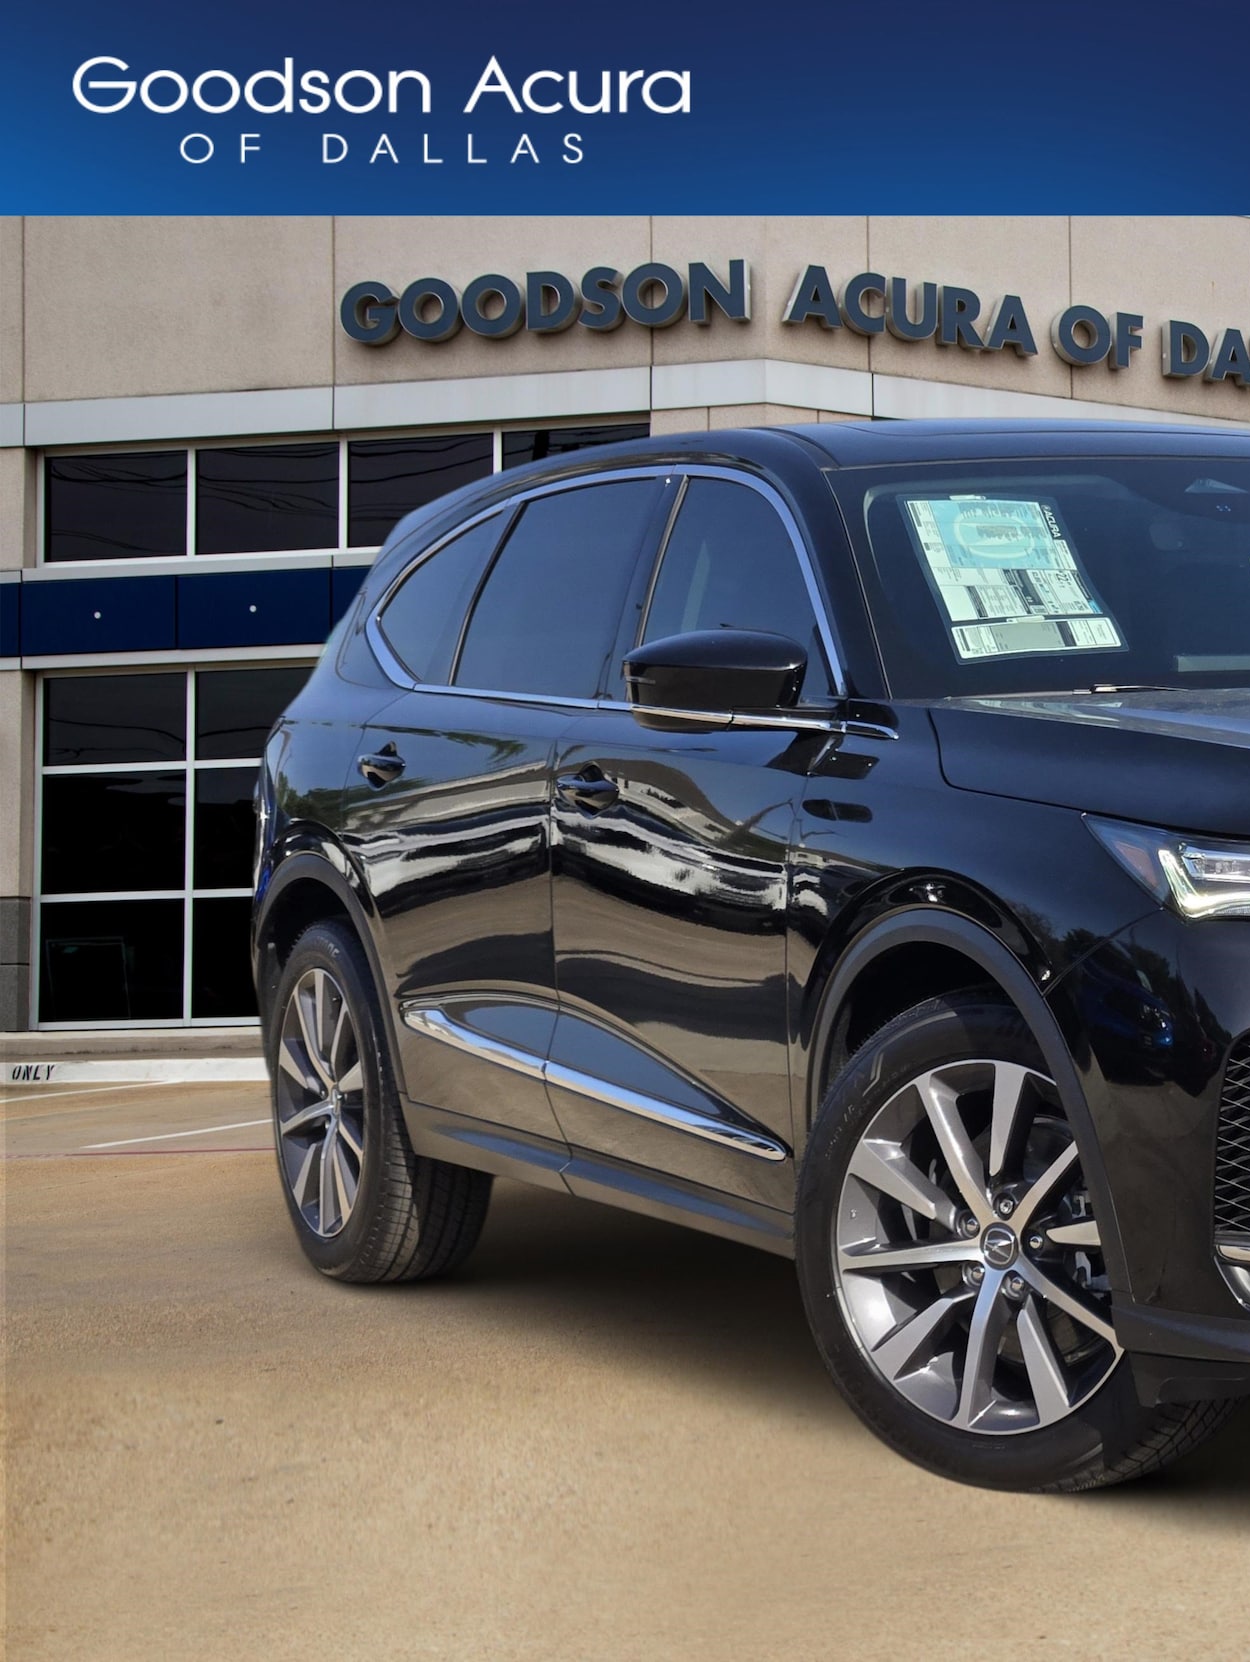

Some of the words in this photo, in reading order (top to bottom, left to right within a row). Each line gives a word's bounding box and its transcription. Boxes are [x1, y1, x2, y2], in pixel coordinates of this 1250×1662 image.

[340, 258, 752, 347] GOODSON
[783, 264, 1038, 357] ACURA
[1052, 304, 1144, 370] OF
[1044, 510, 1062, 538] ACURA
[12, 1064, 55, 1081] ONLY
